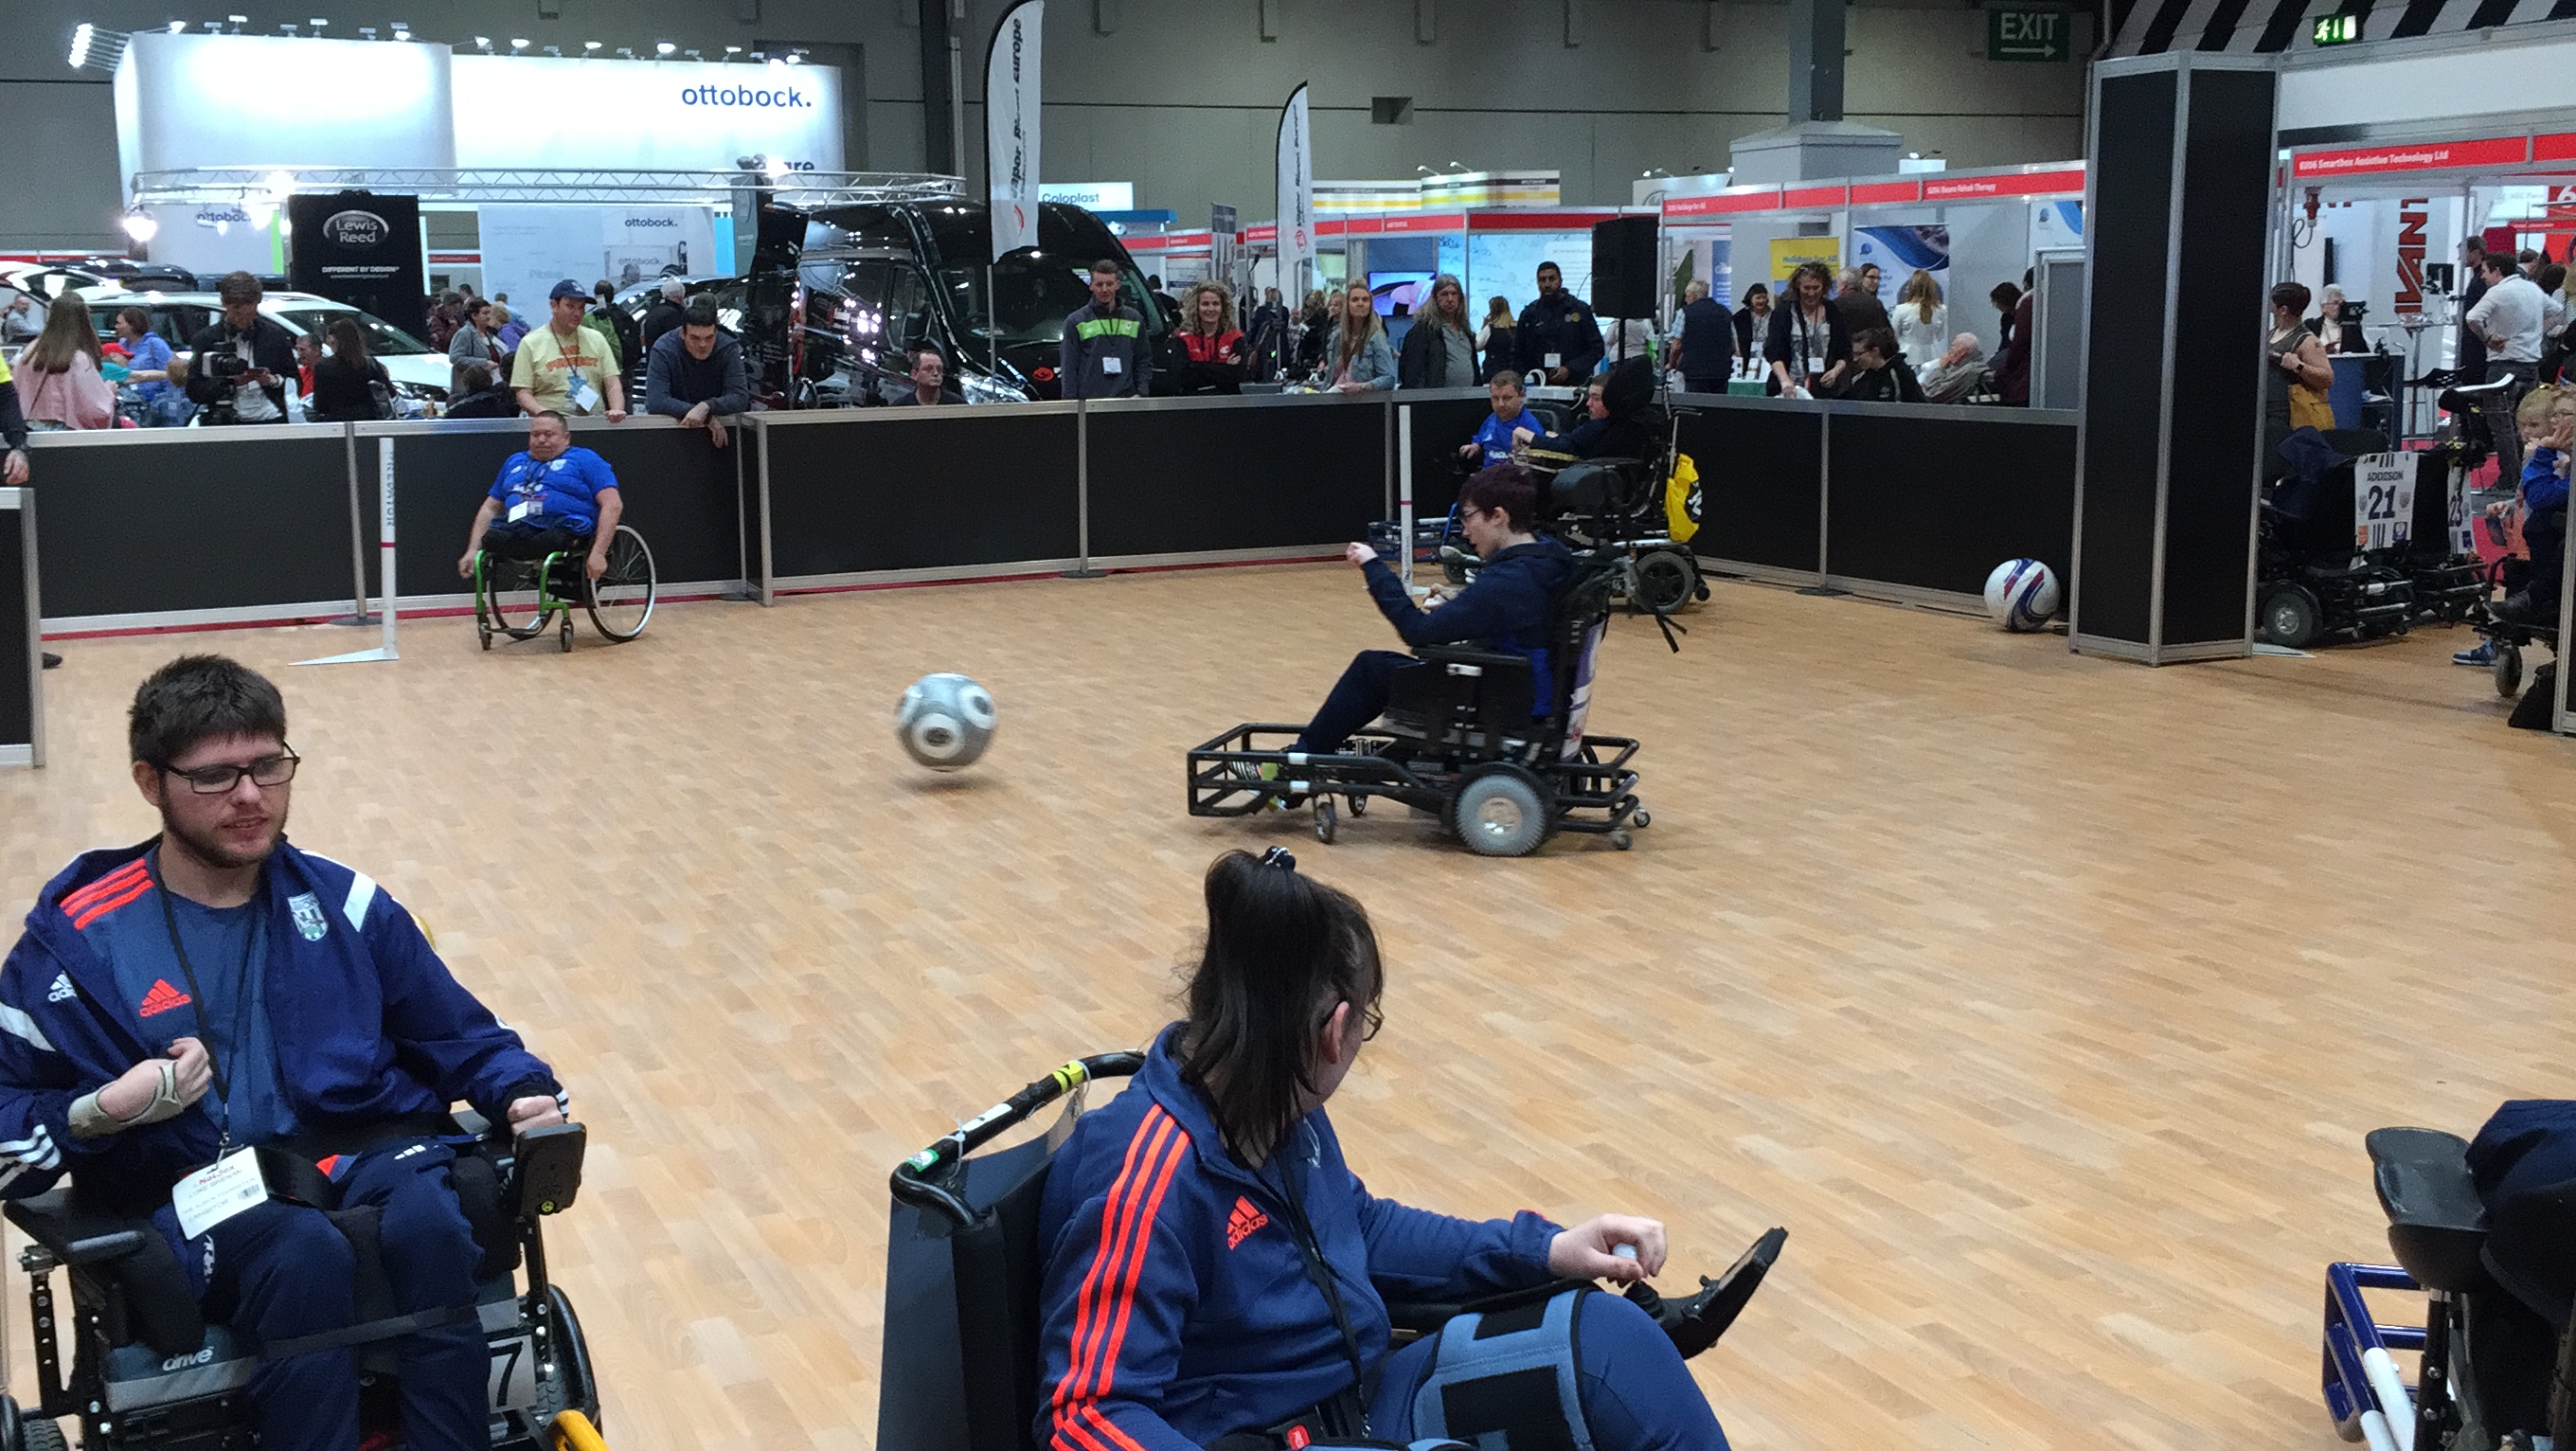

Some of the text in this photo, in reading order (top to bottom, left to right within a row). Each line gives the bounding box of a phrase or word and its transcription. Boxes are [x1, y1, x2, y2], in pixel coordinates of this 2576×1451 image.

[2000, 12, 2059, 40] EXIT
[682, 84, 812, 107] ottobock.
[1042, 192, 1100, 204] Coloplast
[336, 219, 378, 232] Lewis
[624, 216, 678, 227] ottobock.
[339, 231, 376, 243] Reed
[2368, 485, 2397, 520] 21
[139, 994, 192, 1017] adidas
[1227, 1213, 1269, 1250] adidas
[487, 1339, 524, 1408] 7
